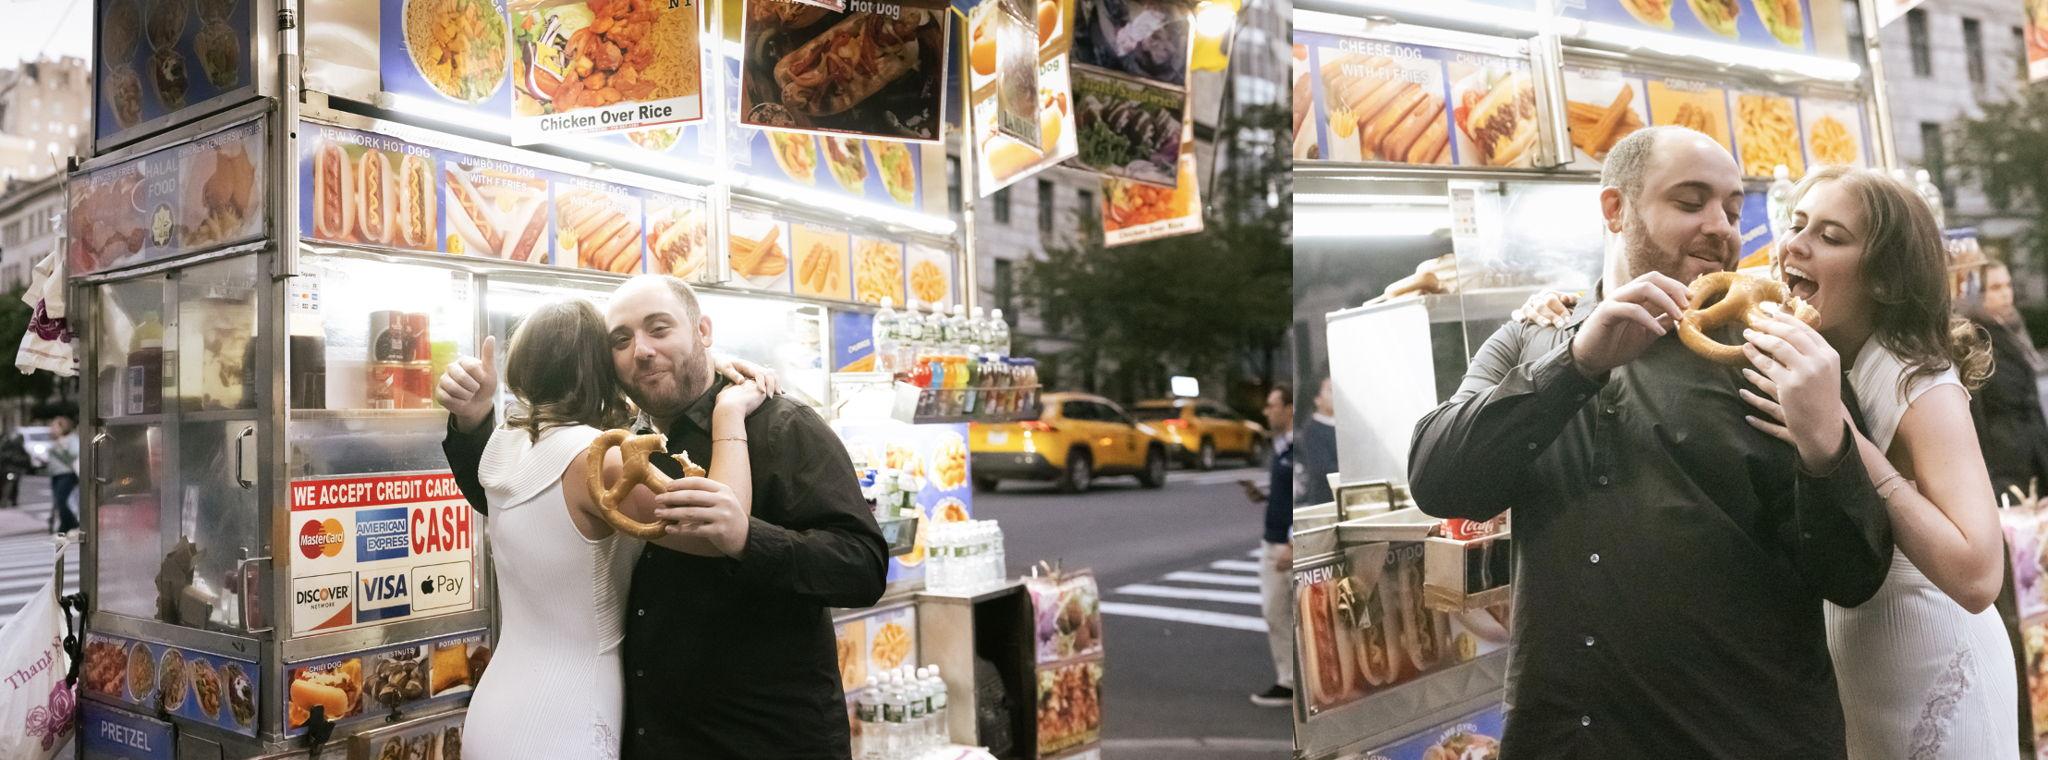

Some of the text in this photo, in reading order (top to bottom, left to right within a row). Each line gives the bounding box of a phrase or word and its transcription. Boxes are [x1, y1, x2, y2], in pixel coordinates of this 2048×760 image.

[1339, 40, 1422, 60] CHEESE DOG
[1039, 59, 1060, 76] Dog
[540, 113, 596, 132] Chicken
[600, 109, 635, 125] Over
[639, 104, 672, 120] Rice
[320, 128, 431, 158] NEW YORK HOT DOG
[145, 158, 178, 178] HALAL
[461, 156, 536, 178] JUMBO HOT DOG
[148, 178, 176, 197] FOOD
[470, 173, 493, 185] WITH
[502, 178, 529, 192] FRIES
[294, 486, 316, 506] WE
[319, 483, 373, 505] ACCEPT
[376, 480, 422, 500] CREDIT
[356, 520, 405, 535] AMERICAN
[411, 505, 470, 555] CASH
[300, 531, 344, 547] MasterCard
[368, 536, 409, 551] EXPRESS
[1303, 565, 1334, 586] NEW
[1386, 549, 1402, 565] OT
[1406, 544, 1424, 560] DO
[361, 574, 408, 601] VISA
[437, 575, 464, 595] Pay
[296, 586, 349, 605] DISCOVER
[311, 602, 335, 610] NETWORK
[439, 635, 480, 648] POTATO KNISH
[3, 650, 53, 690] Thank
[308, 660, 343, 674] CHILI DOG
[101, 720, 151, 751] PRETZEL
